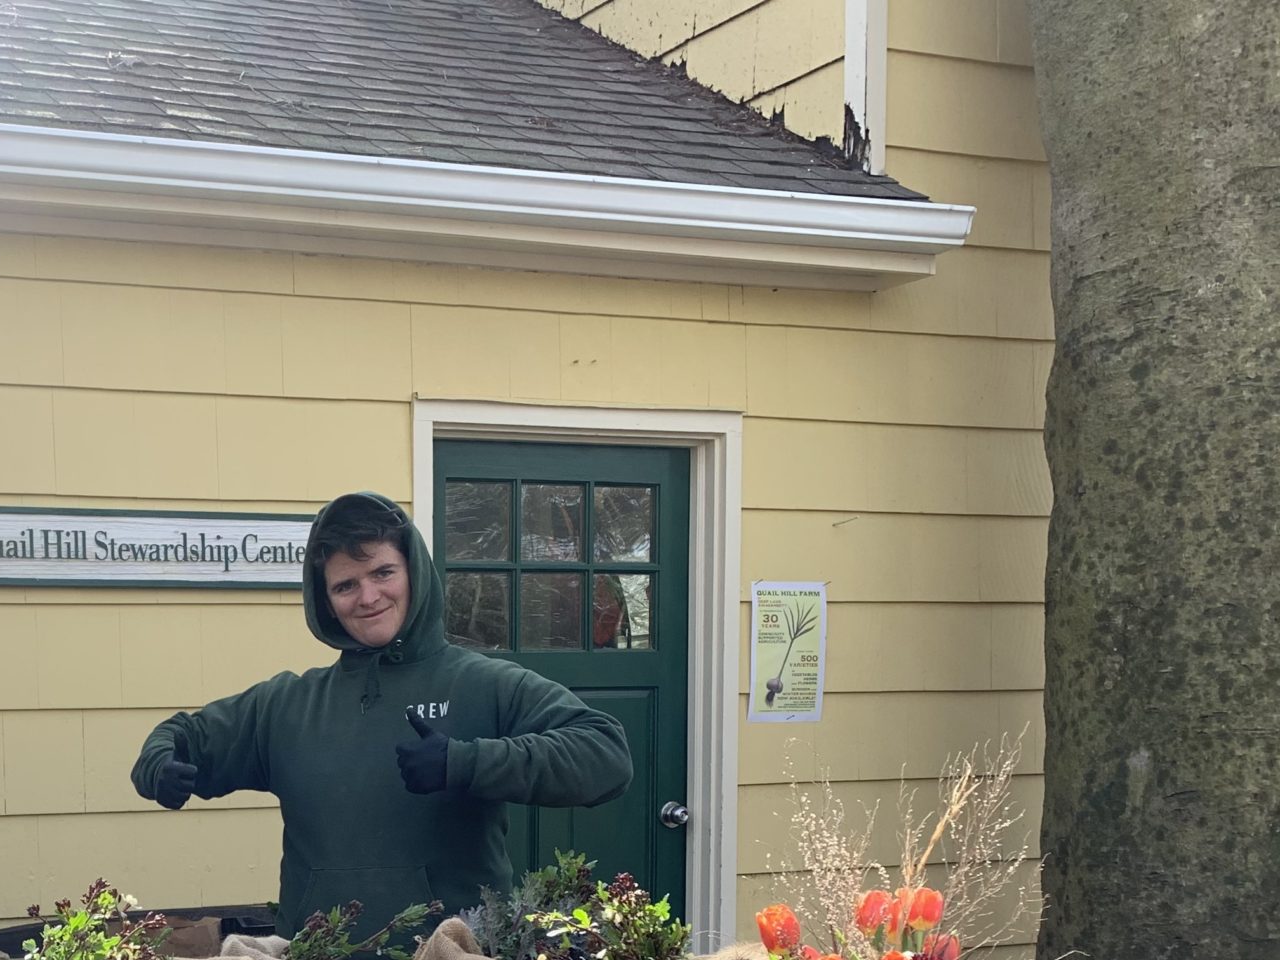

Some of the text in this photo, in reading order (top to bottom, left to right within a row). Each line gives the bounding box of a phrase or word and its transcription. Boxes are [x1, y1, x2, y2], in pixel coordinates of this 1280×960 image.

[41, 529, 88, 561] Hill
[94, 531, 237, 572] Stewardship
[241, 533, 306, 565] Cente
[762, 614, 779, 623] 30
[801, 654, 819, 662] 500
